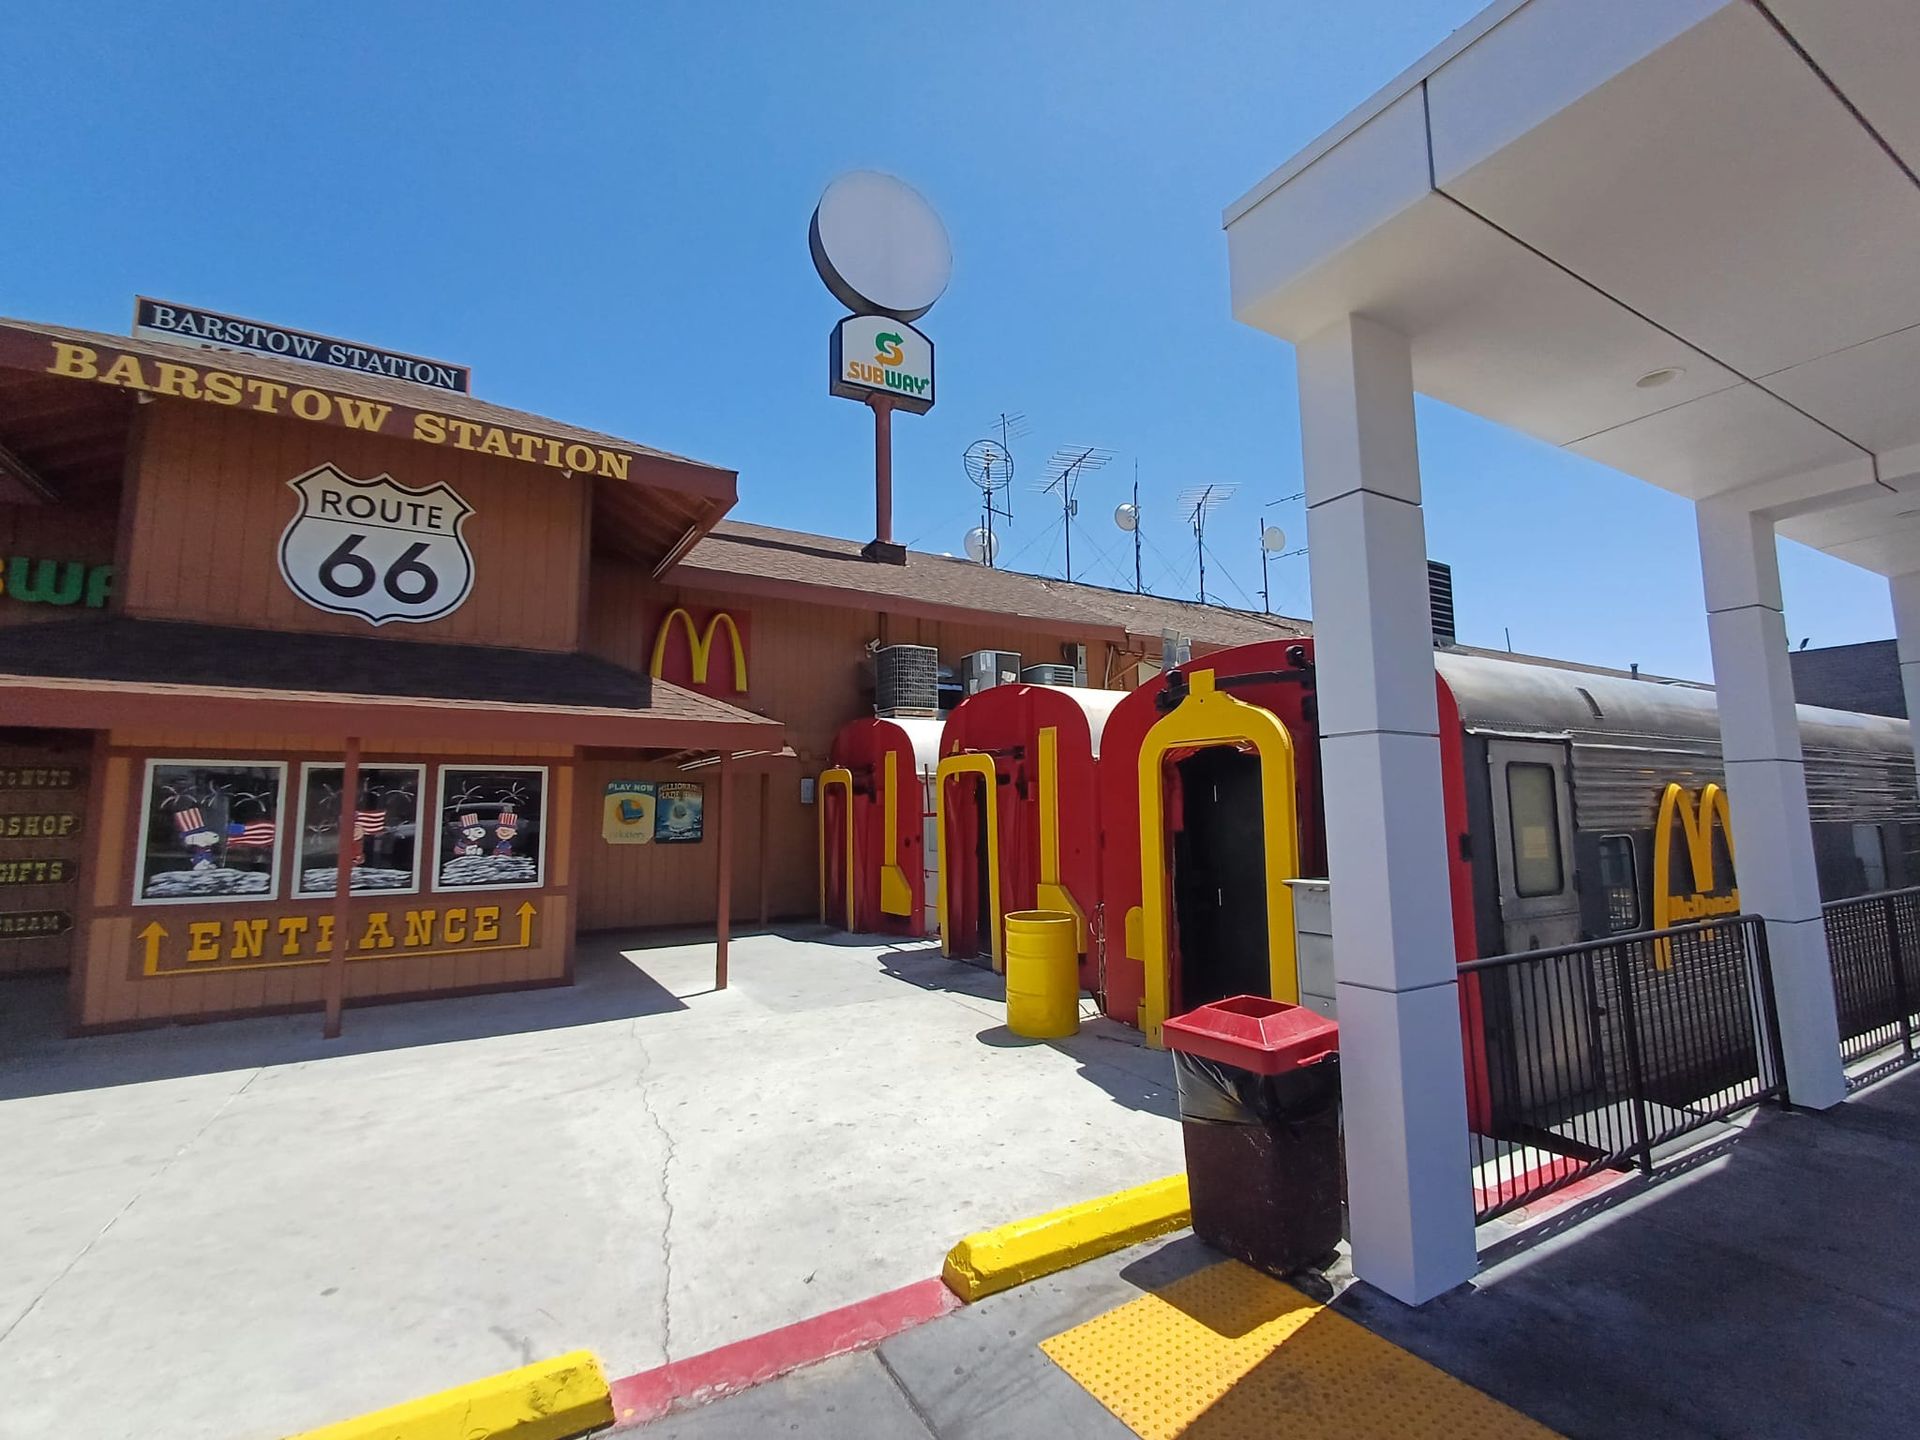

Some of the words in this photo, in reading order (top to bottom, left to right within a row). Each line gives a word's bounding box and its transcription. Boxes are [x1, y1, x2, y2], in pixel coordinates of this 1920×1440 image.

[151, 305, 322, 360] BARSTOW
[328, 345, 458, 390] STATION
[847, 361, 930, 394] SUBWAY
[46, 342, 392, 433] BARSTOW
[413, 413, 632, 480] STATION
[321, 490, 443, 529] ROUTE
[318, 534, 439, 605] 66
[608, 783, 634, 791] PLAY
[633, 784, 654, 792] NOW
